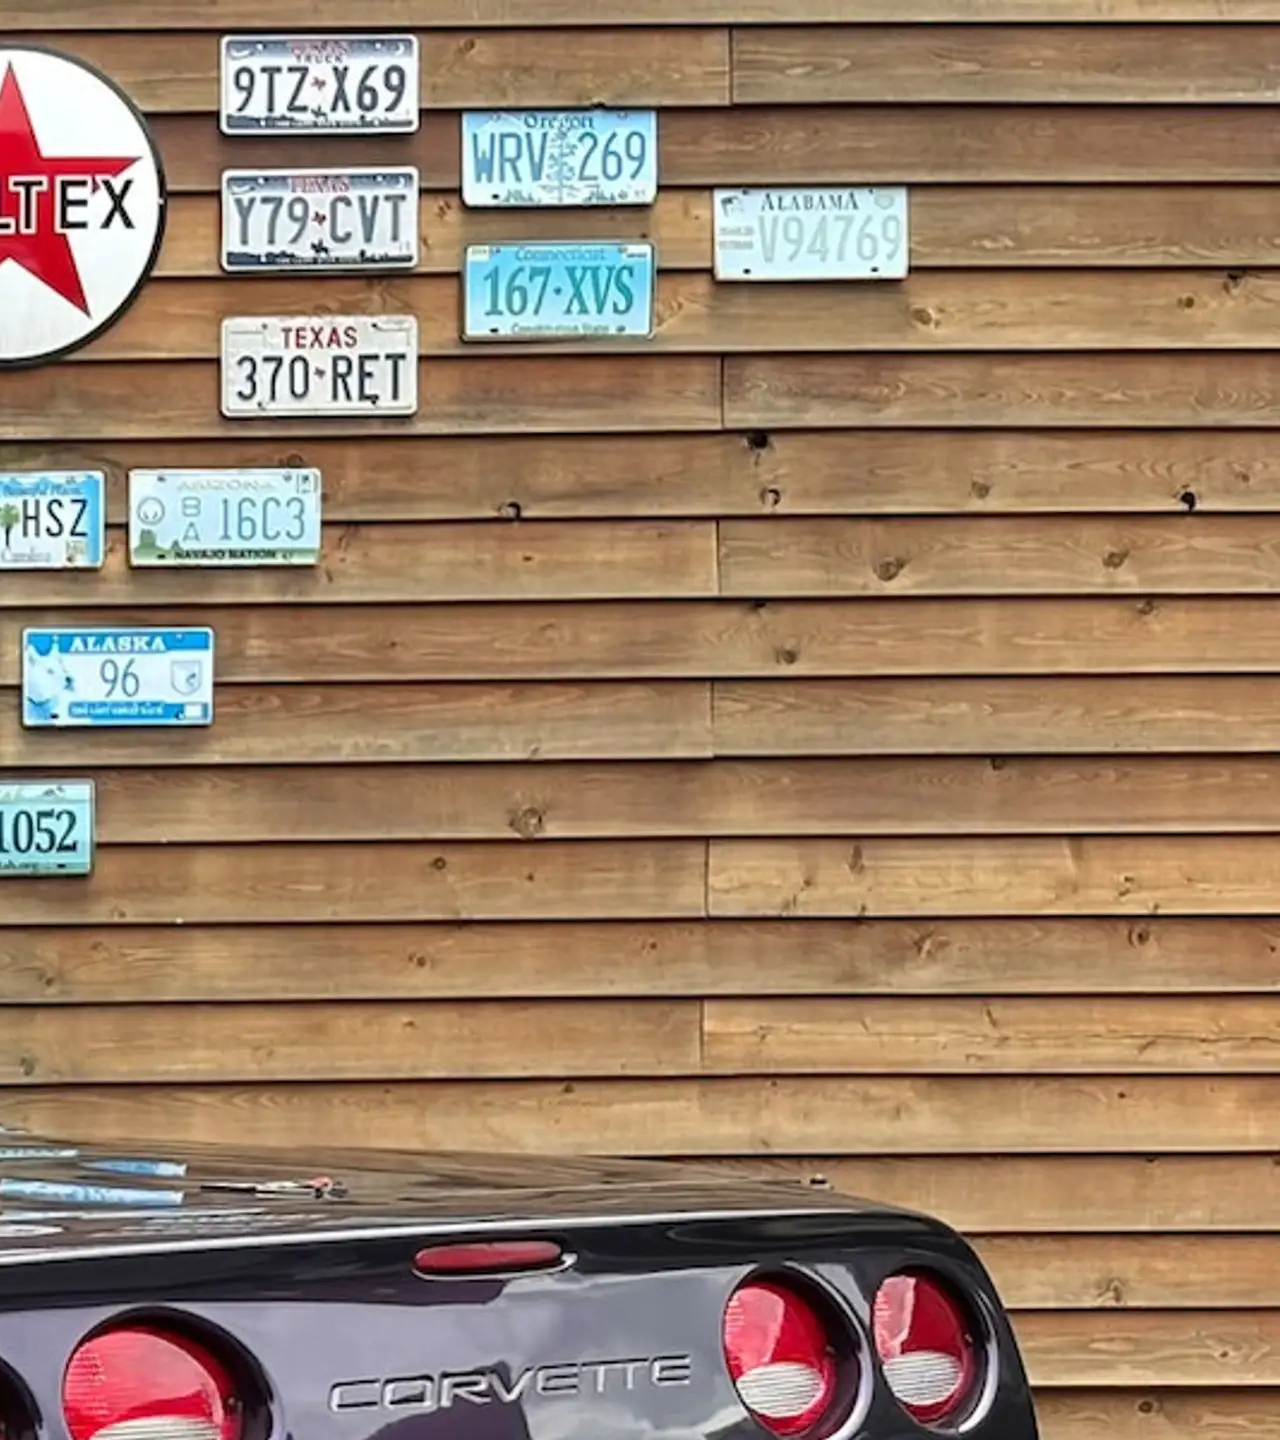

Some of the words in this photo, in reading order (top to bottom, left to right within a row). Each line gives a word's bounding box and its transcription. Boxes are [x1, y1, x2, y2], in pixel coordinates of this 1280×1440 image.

[524, 112, 595, 132] Oregon
[761, 191, 859, 211] ALABAMA
[757, 214, 901, 262] V94769
[281, 326, 358, 349] TEXAS
[174, 550, 225, 560] NAVAJO
[228, 550, 277, 560] NATION
[69, 635, 167, 653] ALASKA
[100, 658, 140, 698] 96
[328, 1353, 691, 1413] CORVETTE
